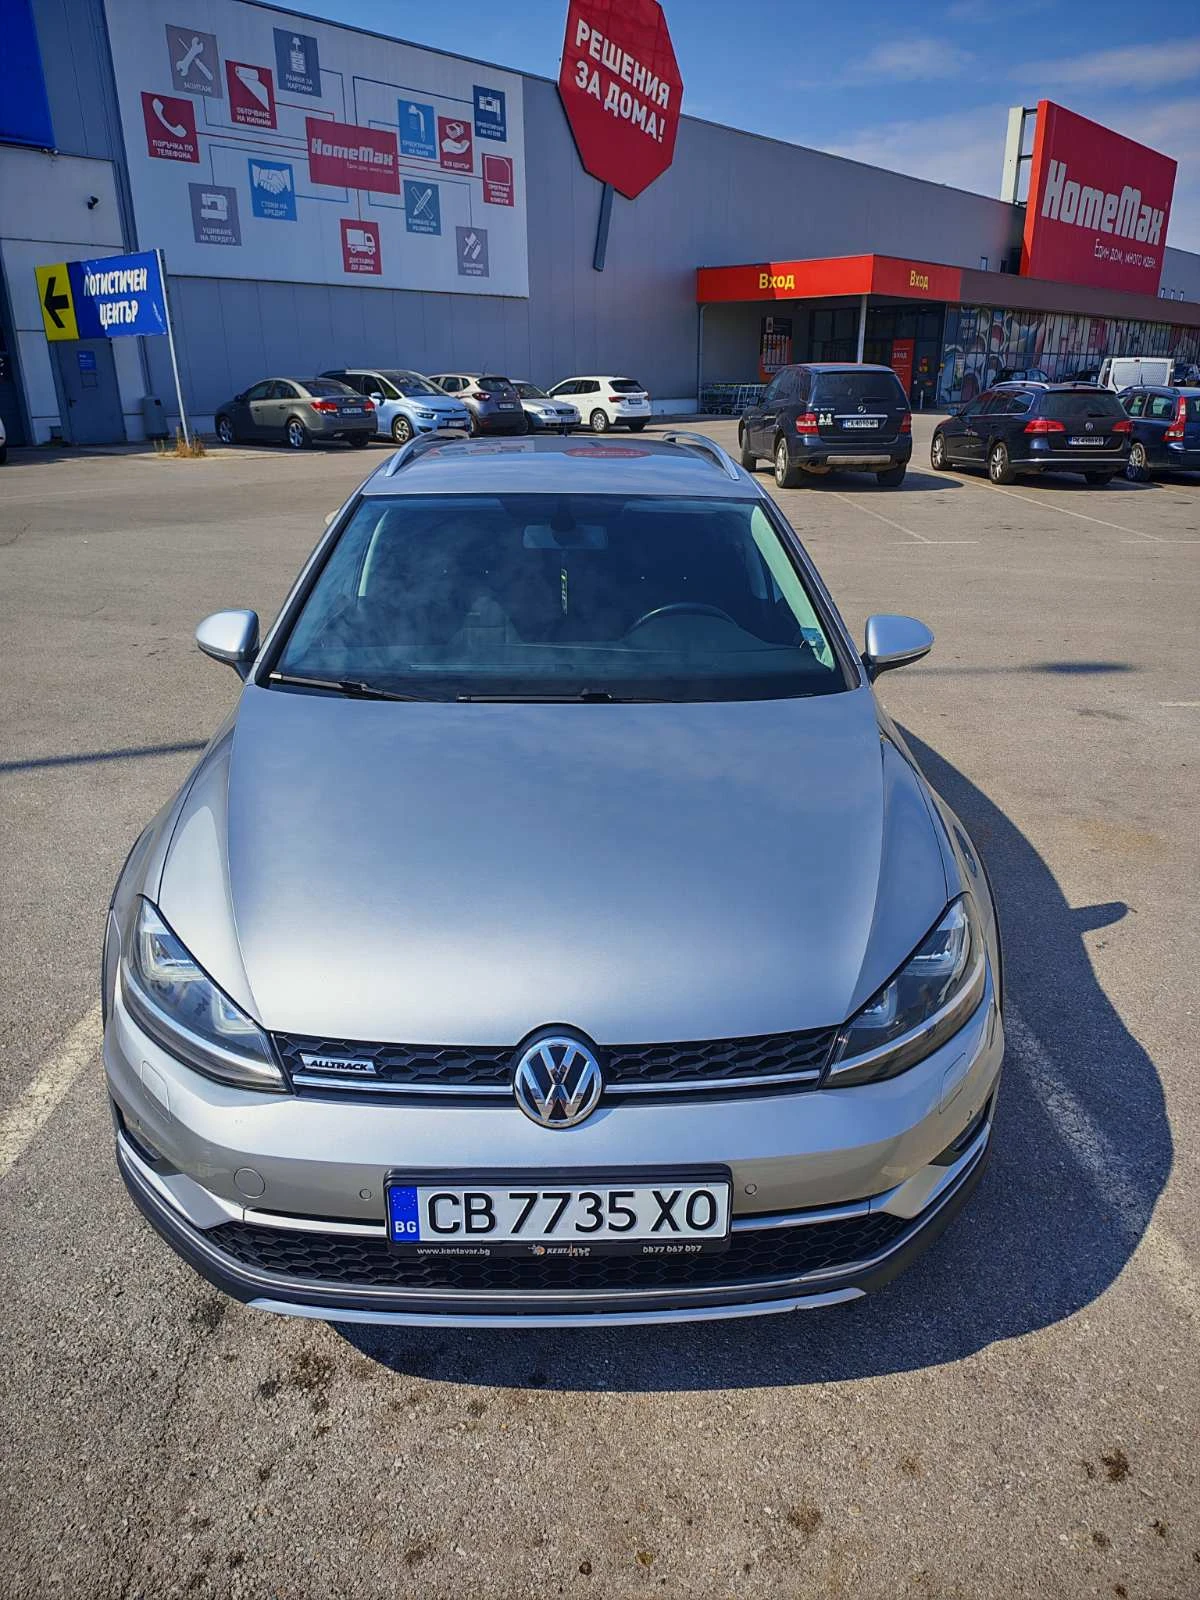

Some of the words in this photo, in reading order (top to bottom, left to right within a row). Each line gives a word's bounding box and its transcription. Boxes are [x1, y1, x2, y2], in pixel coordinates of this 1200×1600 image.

[575, 18, 670, 110] РЕШЕНИЯ
[575, 60, 600, 100] ЗА
[604, 81, 666, 143] ДОМА!
[152, 140, 184, 151] ПОРЪЧКА
[184, 144, 194, 152] ПО
[157, 148, 192, 159] ТЕЛЕФОНА
[311, 137, 393, 166] HomeMax
[1041, 159, 1165, 246] HomeMax
[759, 272, 795, 290] Вход
[909, 270, 929, 291] Вход
[100, 300, 138, 330] ЦЕНТЪР
[309, 1059, 369, 1072] ALLTRACK
[427, 1191, 496, 1234] CB
[508, 1191, 637, 1234] 7735
[650, 1189, 717, 1233] XO
[395, 1221, 417, 1233] BG
[417, 1246, 491, 1257] www.kentavar.bg
